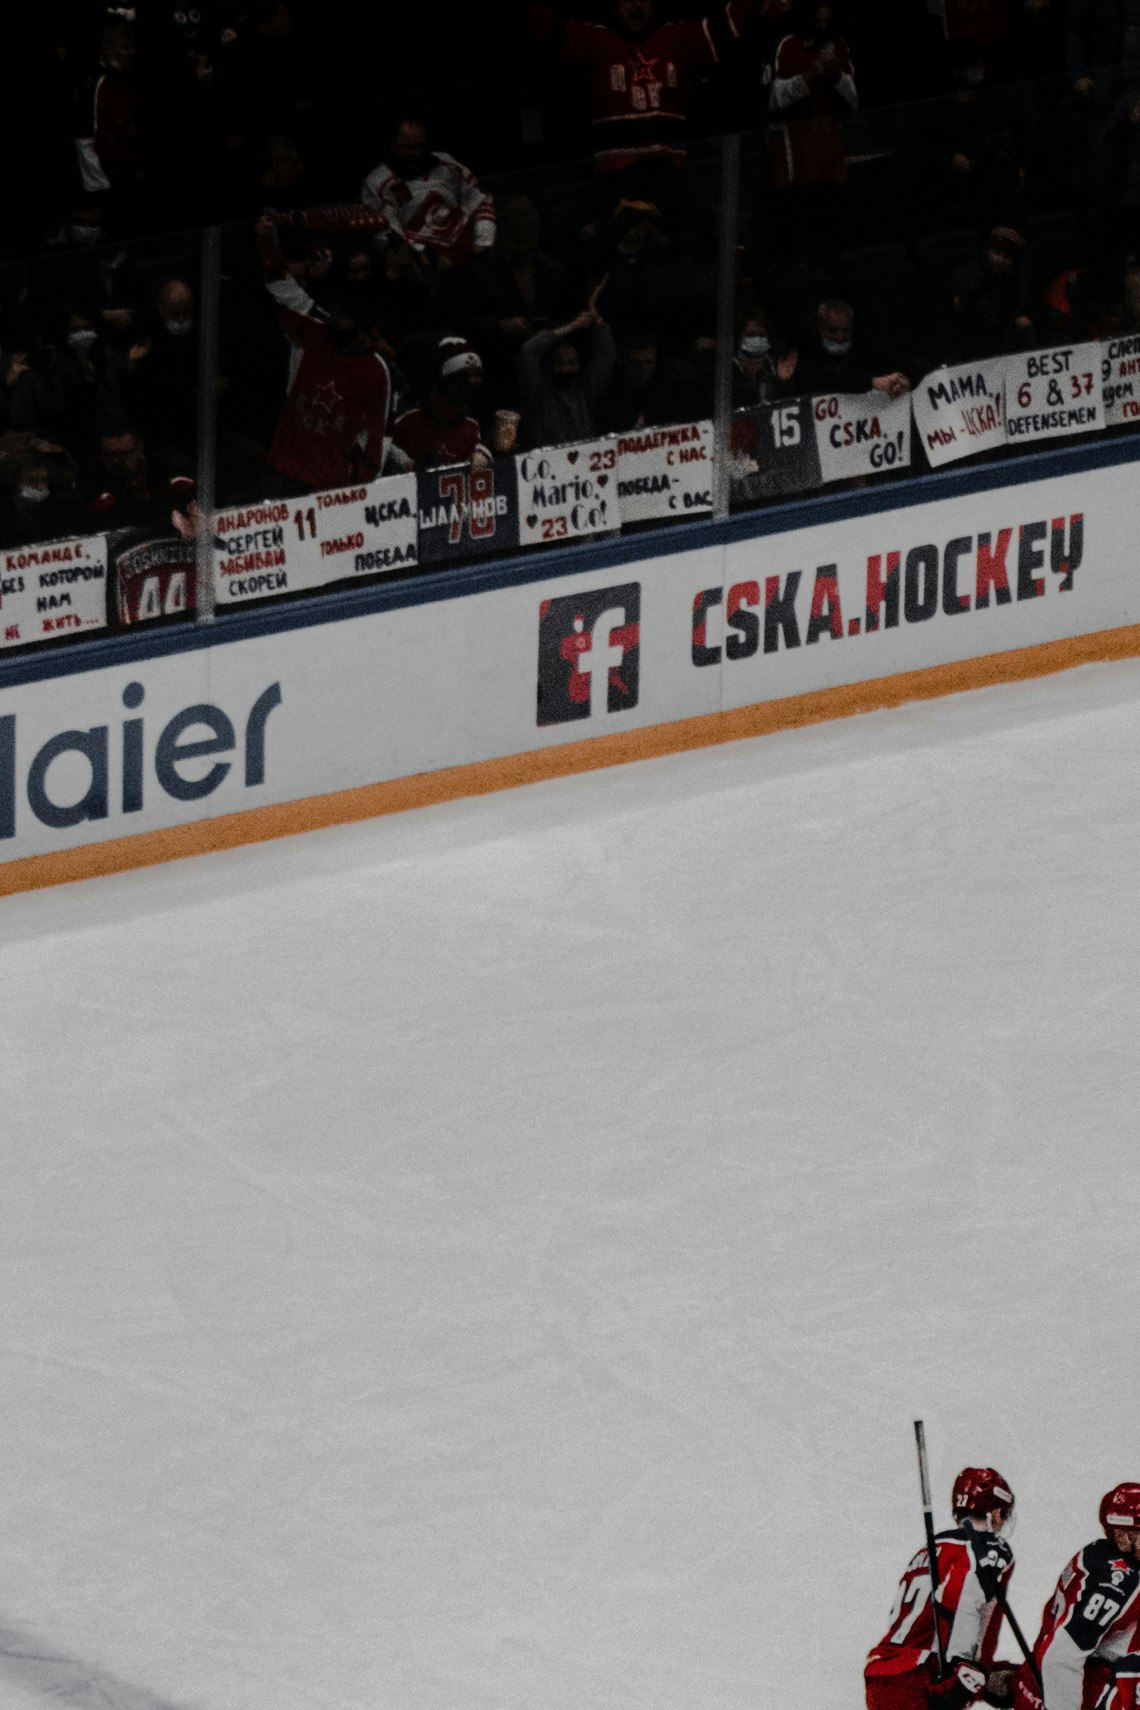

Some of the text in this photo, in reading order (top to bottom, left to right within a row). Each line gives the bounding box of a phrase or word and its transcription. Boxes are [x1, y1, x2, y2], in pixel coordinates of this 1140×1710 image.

[1027, 351, 1074, 378] BEST
[1018, 372, 1094, 408] 6 & 37
[771, 406, 800, 448] 15
[1008, 407, 1097, 436] DEFENSEMEN
[590, 450, 616, 472] 23
[869, 431, 904, 468] GO!
[316, 487, 368, 509] ТОЛЬКО
[439, 469, 496, 544] 78
[683, 491, 712, 509] ВАС
[216, 503, 290, 535] АНДРОНОВ
[294, 507, 317, 541] 11
[541, 516, 568, 539] 23
[227, 524, 284, 555] СЕРГЕЙ
[320, 532, 364, 558] ТОЛЬКО
[354, 543, 417, 572] ПОБЕДА
[39, 559, 105, 588] КОТОРОЙ
[229, 569, 288, 597] СКОРЕЙ
[36, 592, 72, 613] НАМ
[138, 571, 187, 621] 44
[692, 513, 1084, 667] CSKA.HOCKEY
[0, 682, 282, 841] aier
[1083, 1593, 1120, 1627] 87
